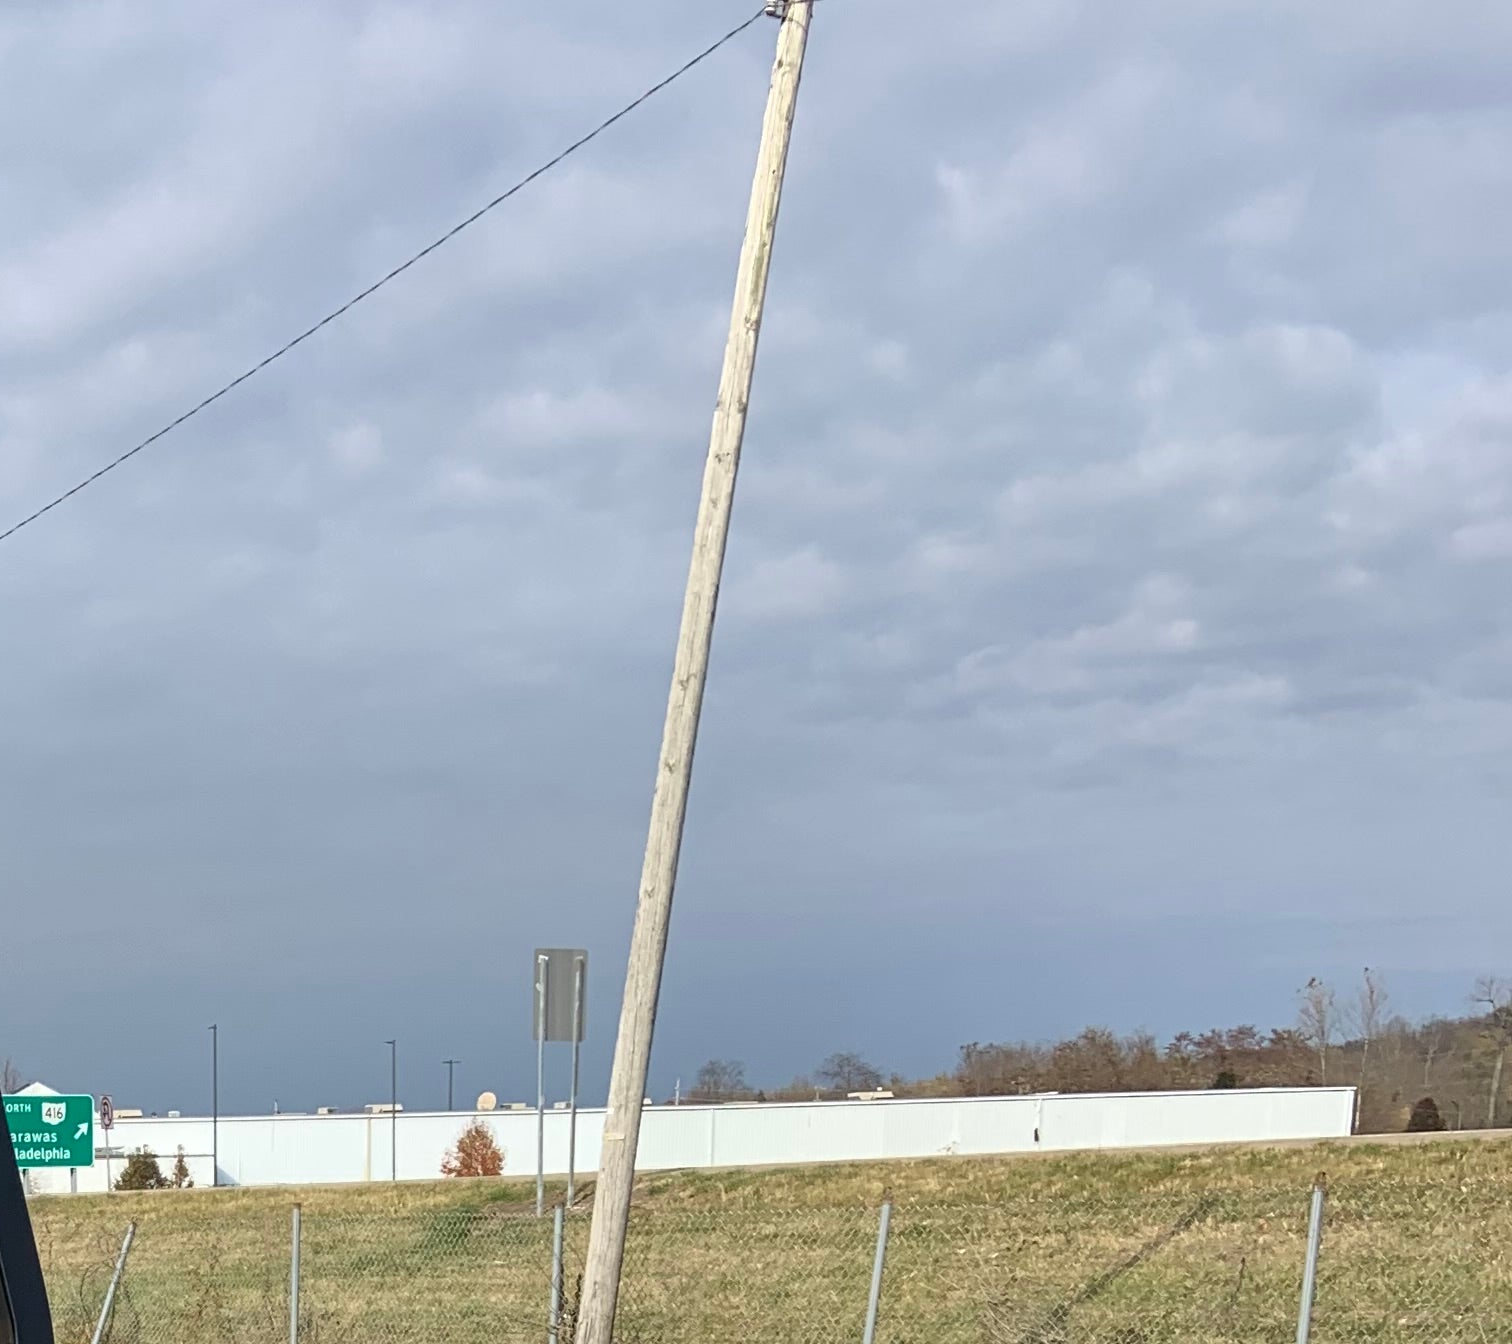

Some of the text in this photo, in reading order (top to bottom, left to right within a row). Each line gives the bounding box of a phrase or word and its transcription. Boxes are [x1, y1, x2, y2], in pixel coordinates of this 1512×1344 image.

[4, 1103, 63, 1119] ORTH 416
[10, 1132, 58, 1143] arawas
[15, 1147, 71, 1162] ladelphia
